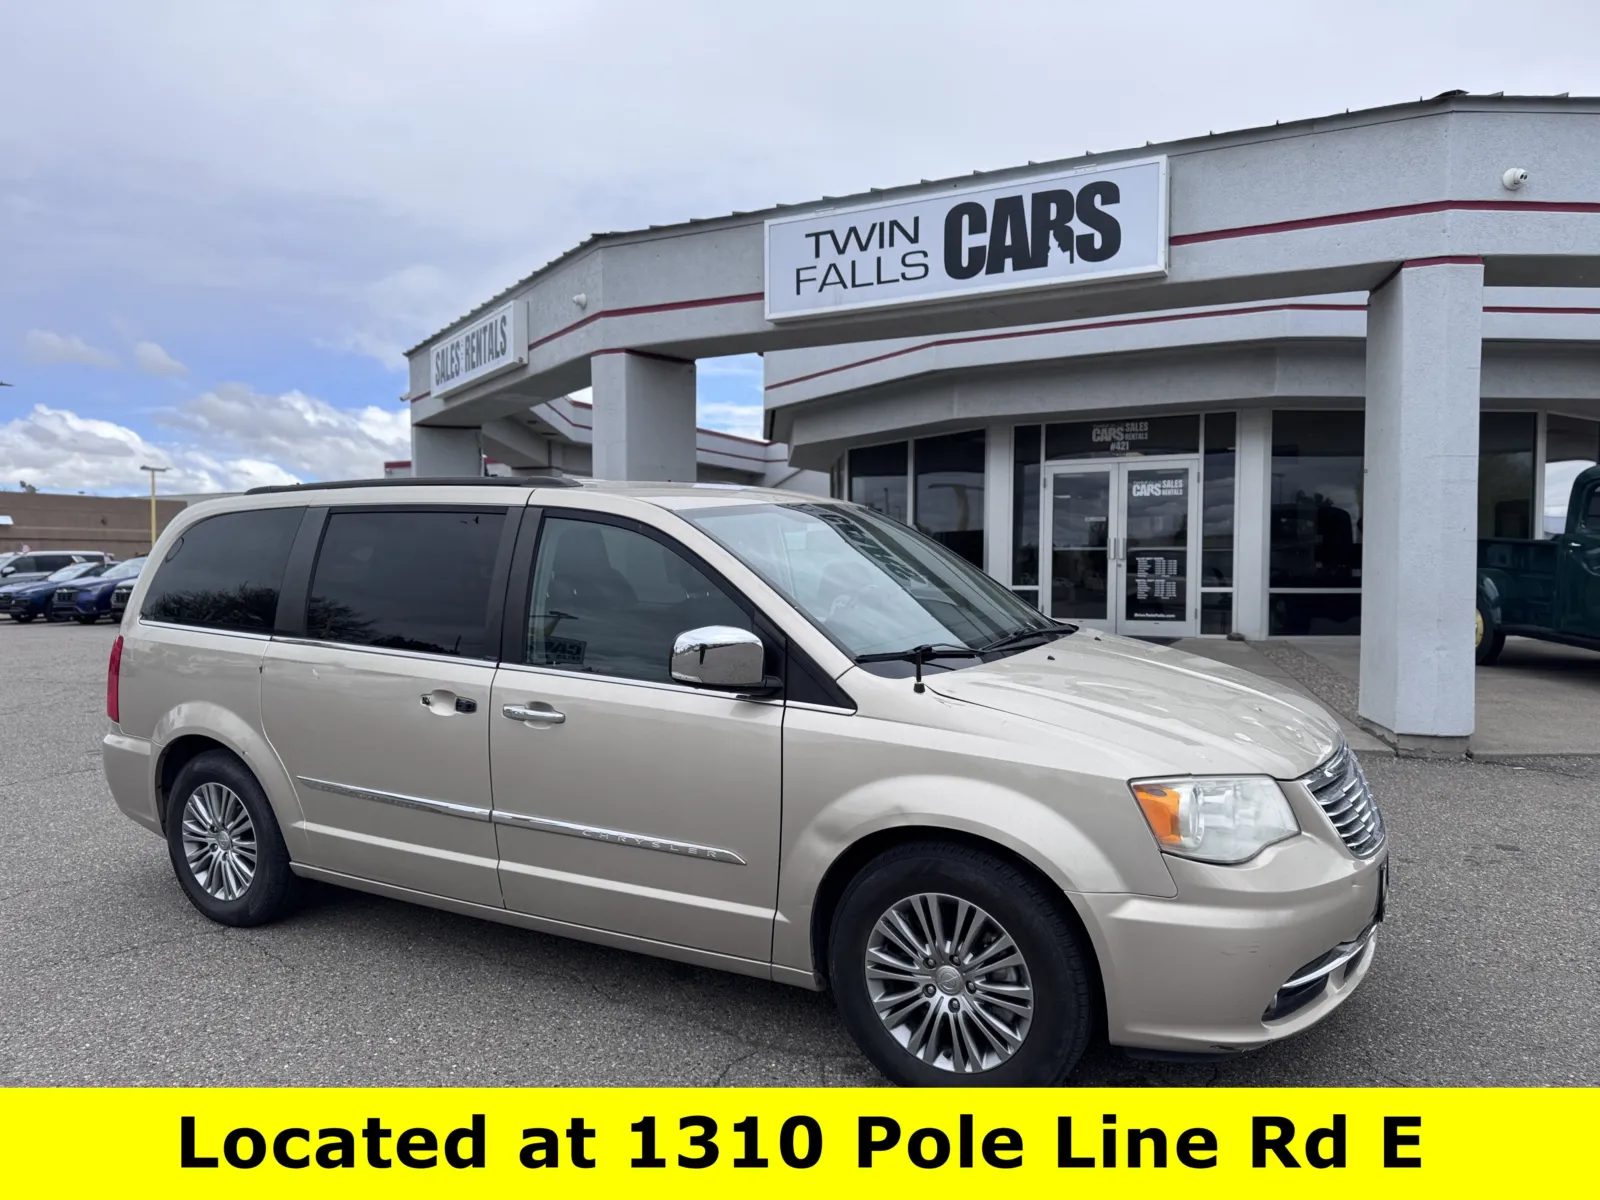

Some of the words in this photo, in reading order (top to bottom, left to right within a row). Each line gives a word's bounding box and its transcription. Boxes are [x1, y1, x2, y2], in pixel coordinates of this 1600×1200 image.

[805, 216, 920, 259] TWIN
[944, 181, 1121, 280] CARS
[796, 250, 930, 296] FALLS
[435, 340, 460, 386] SALES
[465, 315, 507, 373] RENTALS
[1092, 427, 1124, 442] CARS
[1125, 421, 1148, 432] SALES
[1110, 441, 1130, 451] #421
[1132, 483, 1161, 496] CARS
[1162, 479, 1183, 488] SALES
[582, 829, 717, 858] CHRYSLER
